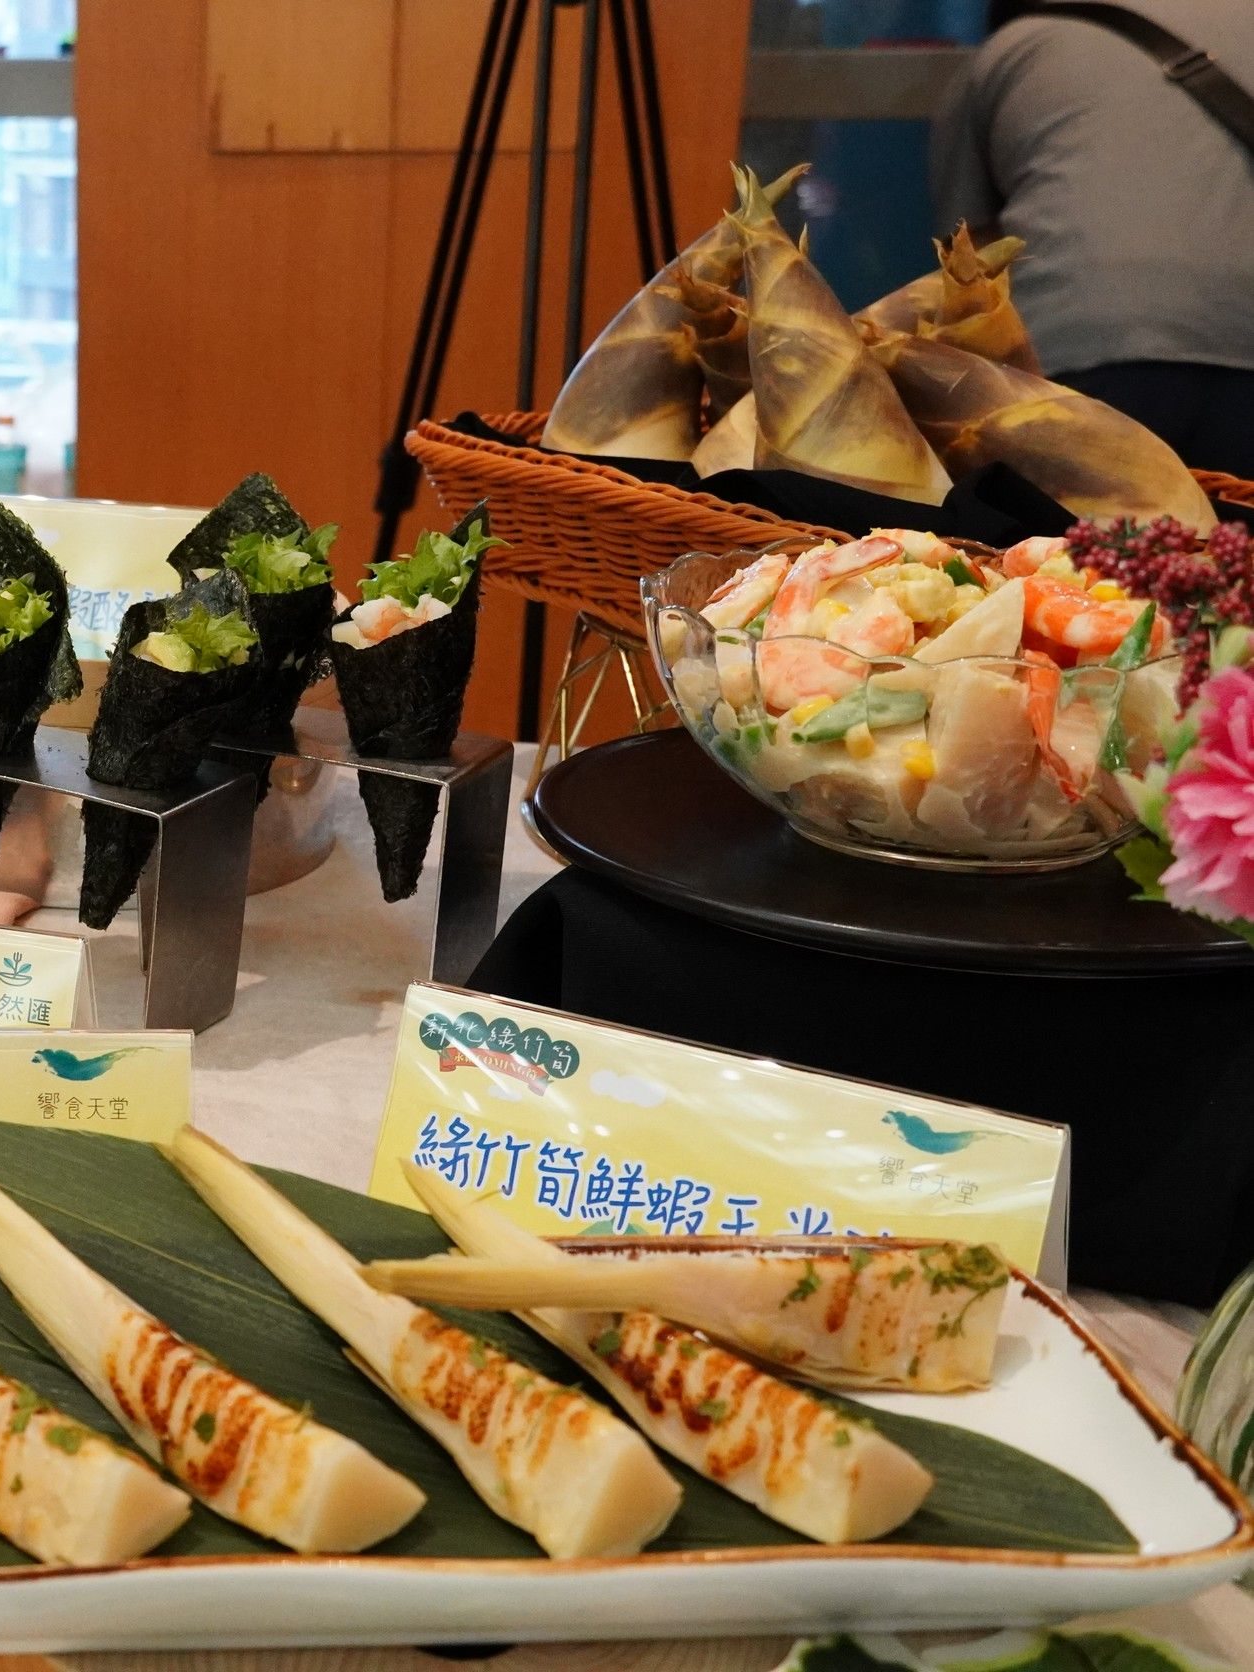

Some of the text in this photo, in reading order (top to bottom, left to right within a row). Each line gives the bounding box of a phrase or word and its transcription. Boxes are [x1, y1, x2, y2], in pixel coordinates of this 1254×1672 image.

[421, 1017, 573, 1076] 新北綠竹筍
[37, 1092, 128, 1119] 饗食天堂
[414, 1115, 888, 1236] 綠竹筍鮮蝦玉
